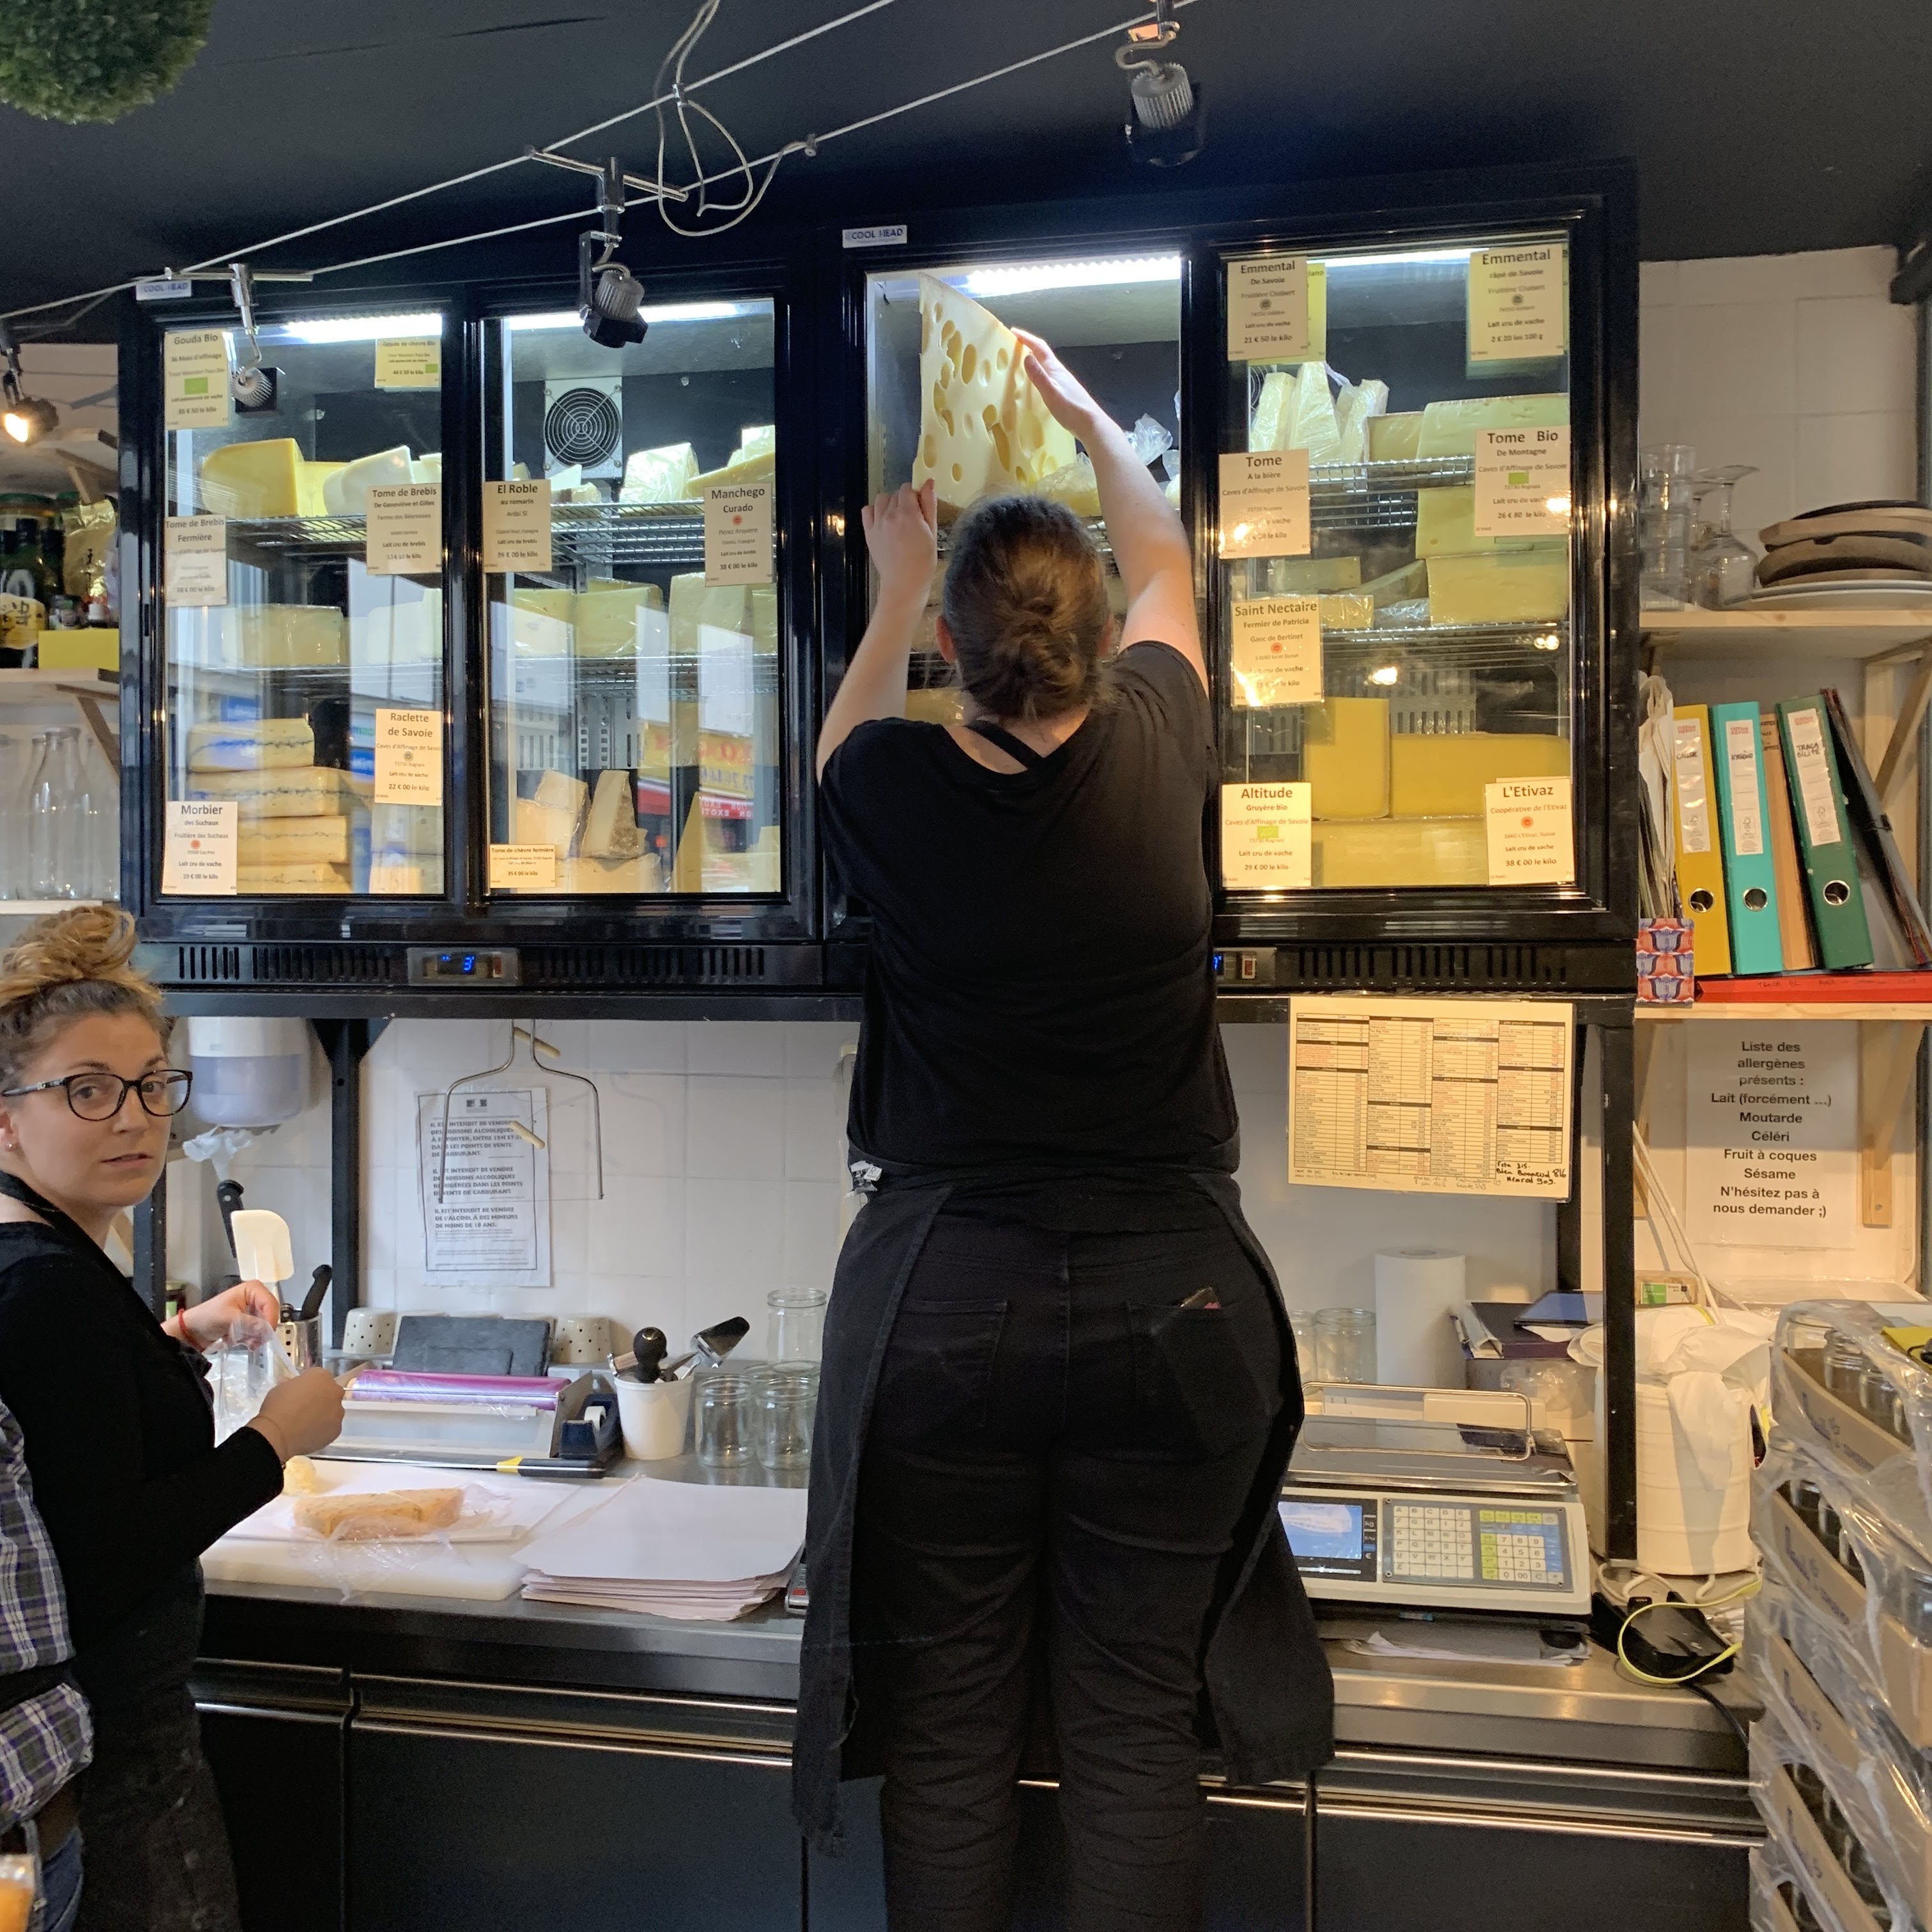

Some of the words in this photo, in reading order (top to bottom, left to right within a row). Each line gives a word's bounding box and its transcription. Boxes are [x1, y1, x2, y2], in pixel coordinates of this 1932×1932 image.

[852, 231, 875, 239] COOL
[879, 229, 903, 237] HEAD
[1483, 249, 1551, 265] Emmental
[1241, 261, 1295, 273] Emmental
[174, 334, 201, 345] Gouda
[204, 334, 218, 342] Bio
[1487, 433, 1526, 443] Tome
[1537, 430, 1558, 441] Bio
[1246, 457, 1282, 467] Tome
[372, 489, 395, 498] Tome
[411, 487, 436, 496] Brebis
[498, 484, 505, 494] El
[509, 484, 538, 493] Roble
[712, 487, 765, 500] Manchego
[723, 503, 753, 513] Curado
[1235, 606, 1264, 617] Saint
[1268, 601, 1317, 614] Nectaire
[1243, 620, 1270, 629] Fermier
[390, 712, 429, 723] Raclette
[388, 727, 399, 736] de
[402, 728, 433, 737] Savoie
[1241, 787, 1292, 799] Altitude
[1503, 785, 1554, 798] L'Etivaz
[181, 805, 223, 815] Morbier
[1742, 1041, 1773, 1052] Liste
[1777, 1041, 1800, 1052] des
[1738, 1058, 1805, 1070] allergènes
[1739, 1075, 1796, 1086] présents
[1711, 1092, 1735, 1103] Lait
[1739, 1094, 1810, 1105] (forcément
[1740, 1112, 1803, 1123] Moutarde
[1752, 1131, 1790, 1141] Céléri
[1724, 1149, 1753, 1160] Fruit
[1757, 1149, 1765, 1160] à
[1769, 1151, 1817, 1163] coques
[1744, 1168, 1796, 1179] Sésame
[1721, 1186, 1781, 1197] N'hésitez
[1785, 1190, 1808, 1200] pas
[1812, 1188, 1820, 1199] à
[1713, 1204, 1745, 1214] nous
[1749, 1204, 1815, 1216] demander
